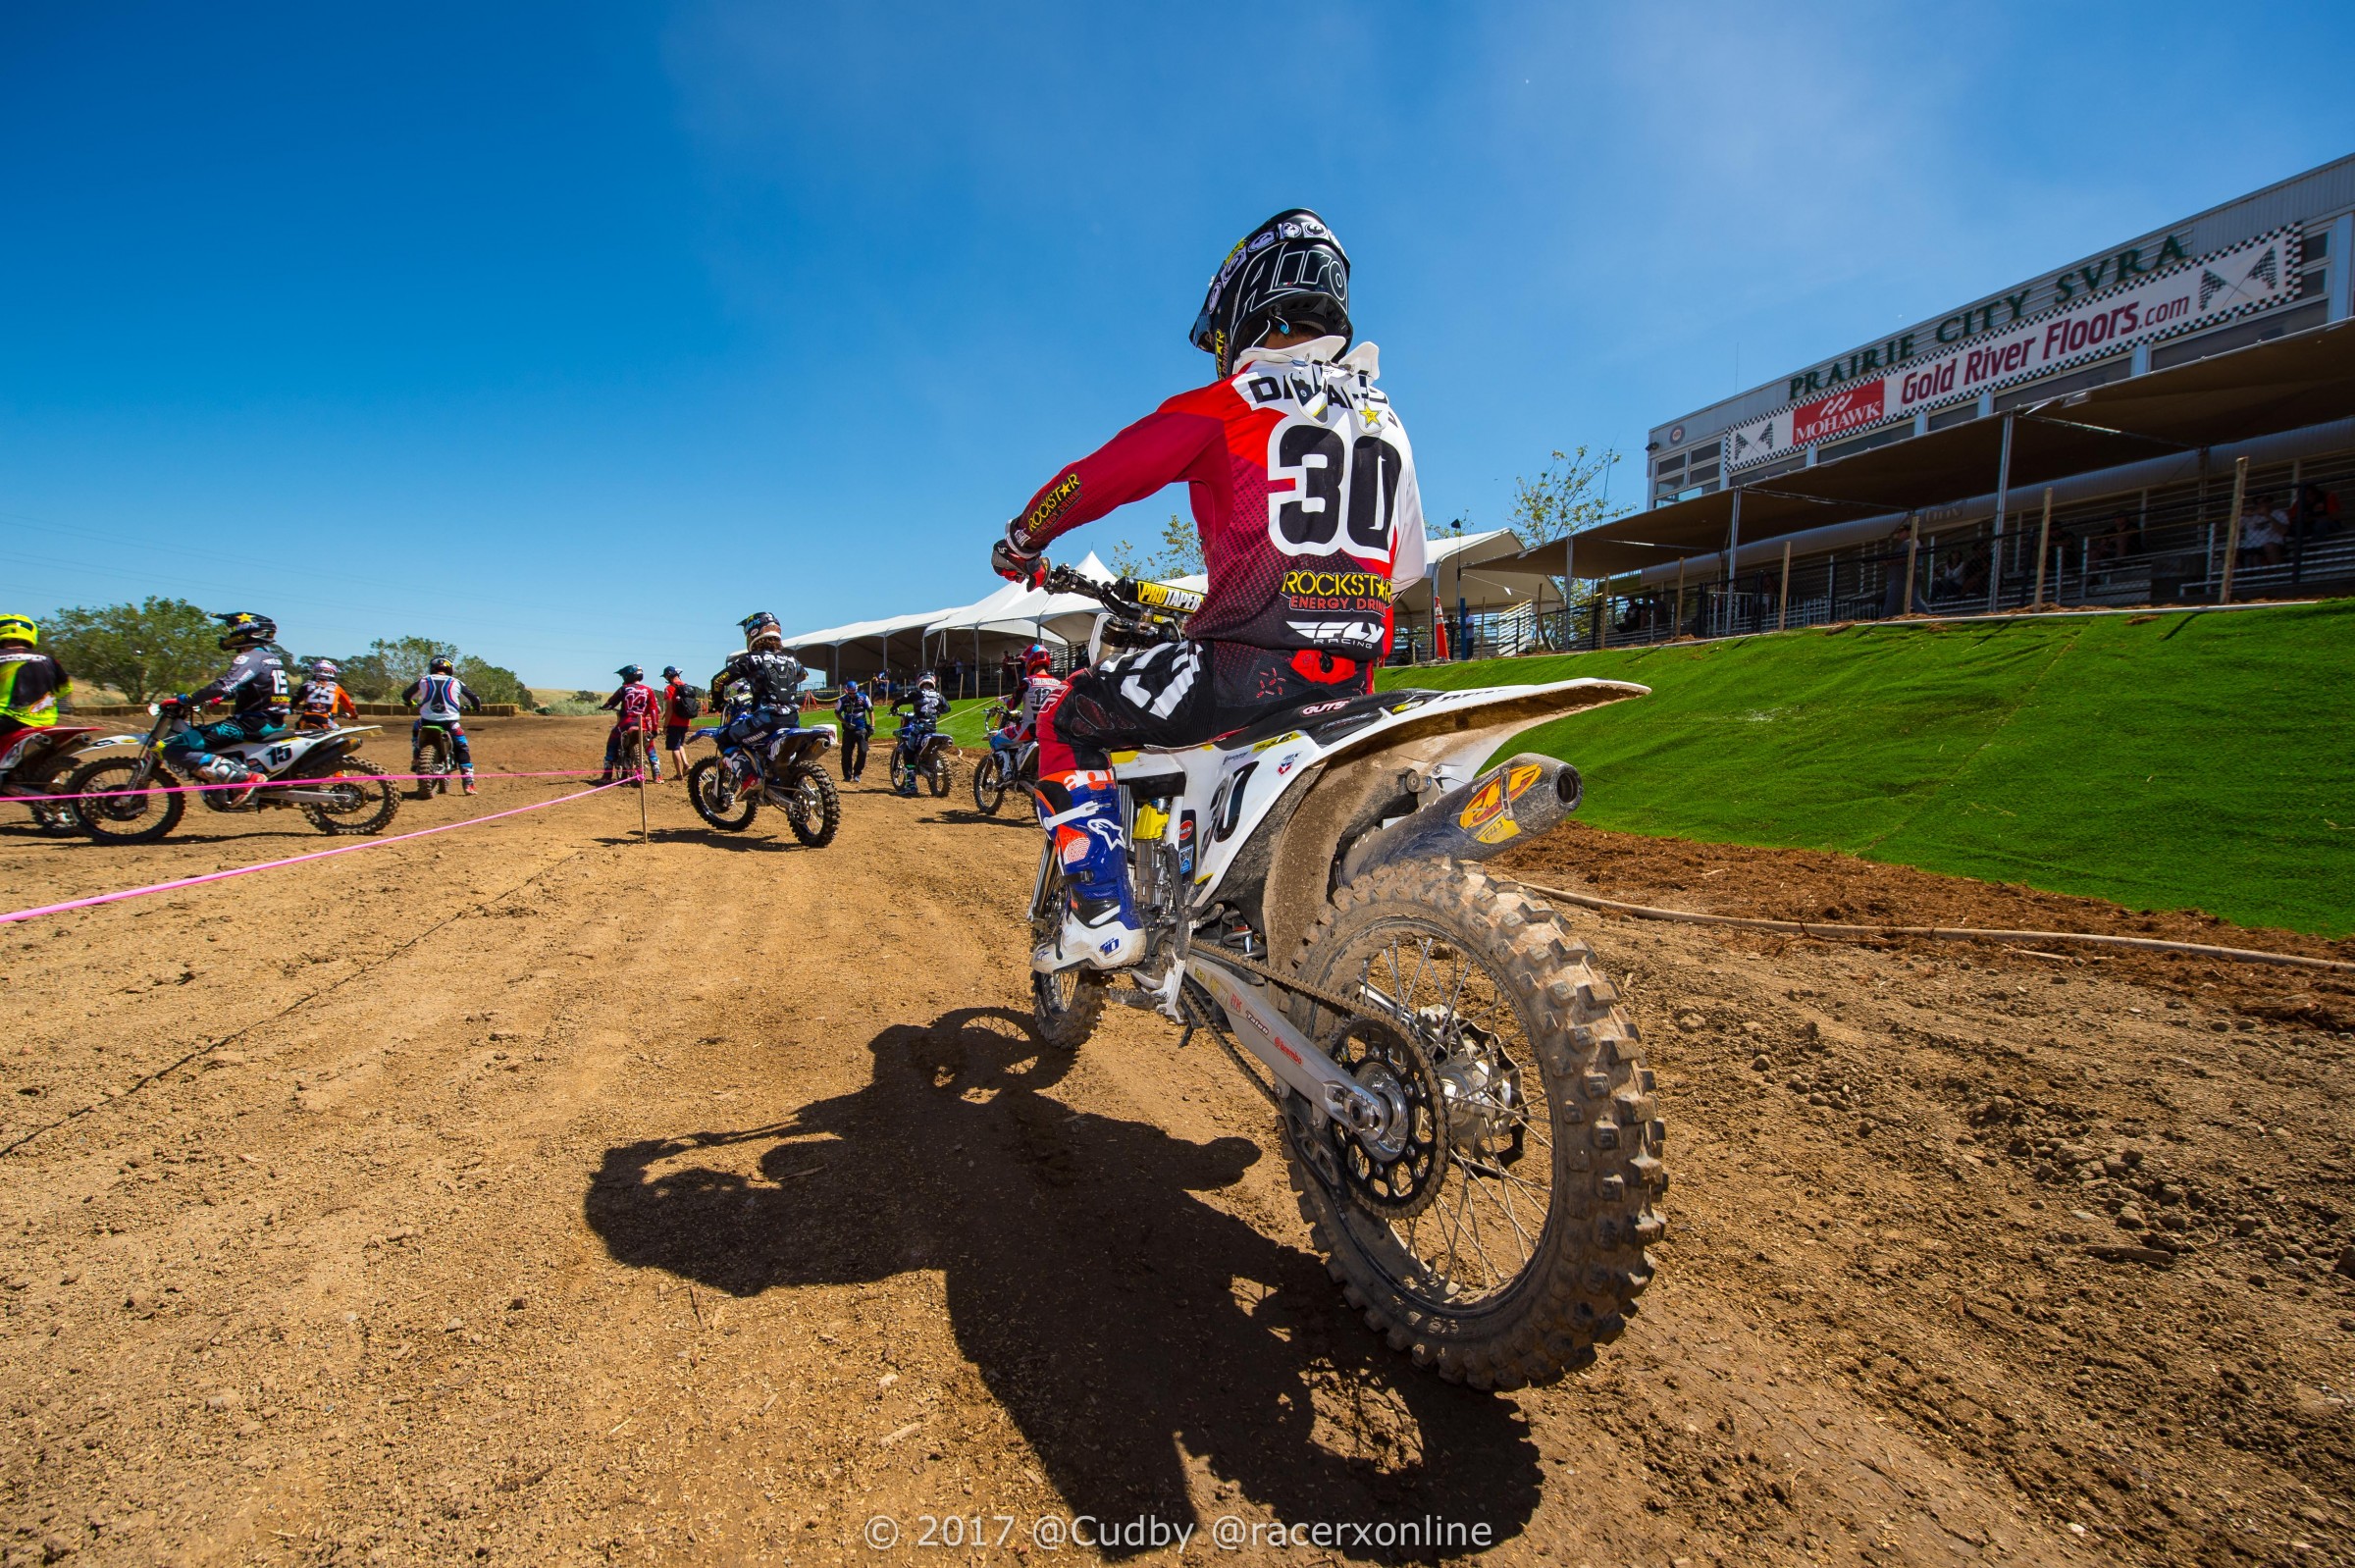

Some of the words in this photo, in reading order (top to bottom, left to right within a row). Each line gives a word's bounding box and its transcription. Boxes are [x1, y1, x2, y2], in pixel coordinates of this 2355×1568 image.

[1789, 334, 1914, 399] PRAIRIE
[1935, 288, 2030, 342] CITY
[2055, 235, 2187, 303] SVRA
[1902, 358, 1957, 404] Gold
[1963, 337, 2035, 386] River
[2043, 295, 2189, 360] Floors.com
[1796, 401, 1879, 441] MOHAWK
[1279, 424, 1402, 548] 30
[1290, 596, 1349, 609] ENERGY
[1313, 638, 1373, 650] RACING
[272, 669, 288, 694] 15
[306, 685, 335, 705] 25
[625, 692, 648, 714] 14
[1302, 698, 1351, 715] GUTS
[266, 745, 292, 766] 15
